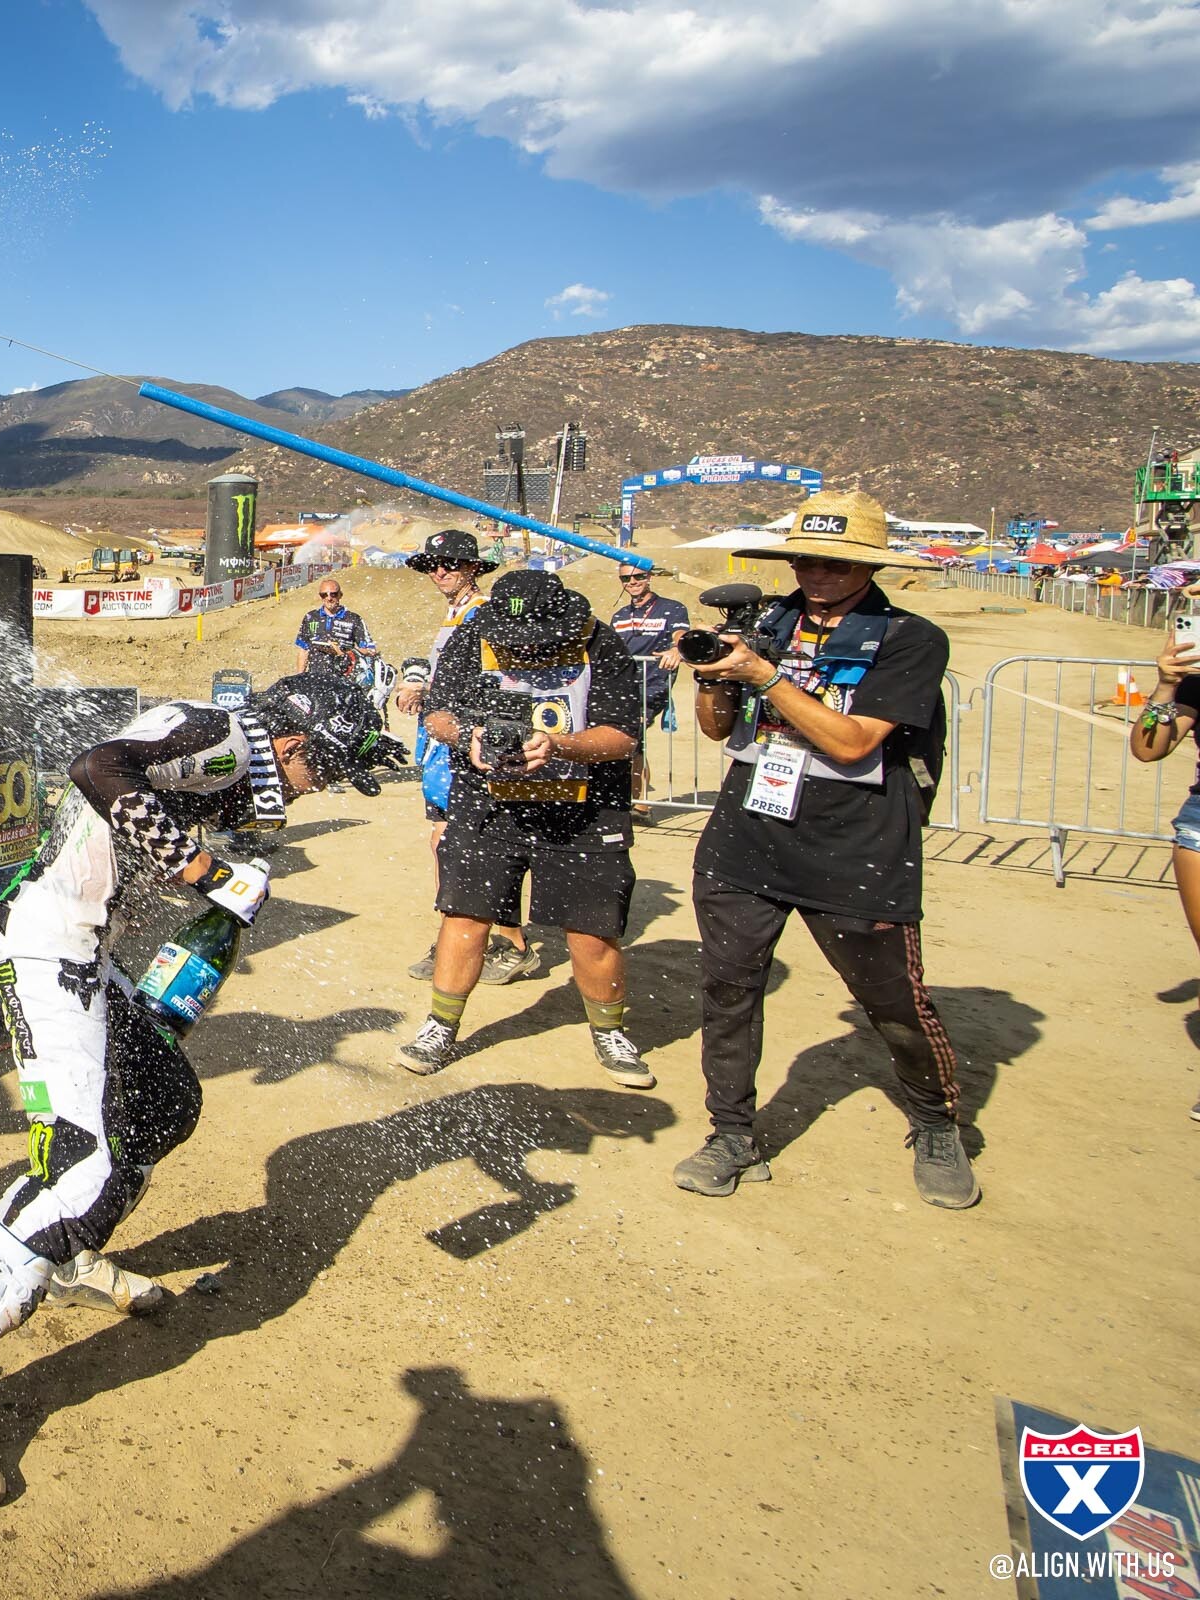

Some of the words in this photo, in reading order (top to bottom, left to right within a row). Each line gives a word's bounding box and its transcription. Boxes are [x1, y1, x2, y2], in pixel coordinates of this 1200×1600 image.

[803, 515, 843, 533] dbk.
[102, 590, 153, 601] PRISTINE
[750, 798, 789, 816] PRESS
